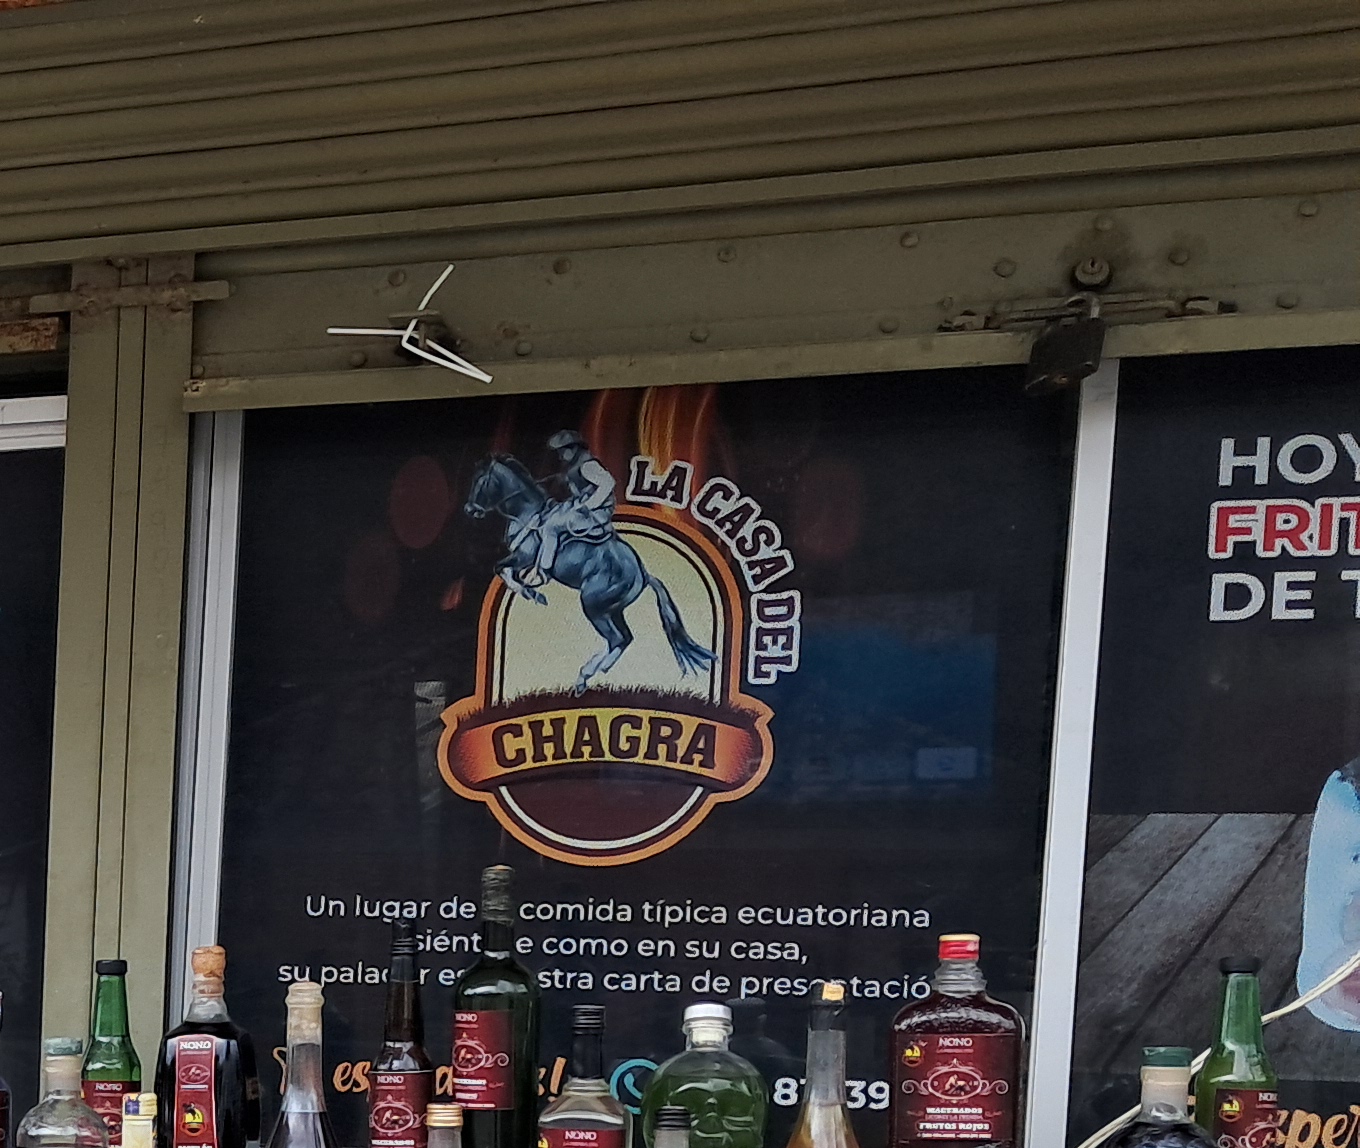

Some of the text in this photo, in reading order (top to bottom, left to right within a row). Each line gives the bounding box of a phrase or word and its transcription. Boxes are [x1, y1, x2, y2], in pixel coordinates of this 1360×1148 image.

[626, 455, 801, 685] LA CASA DEL
[1209, 570, 1317, 621] DE
[492, 714, 716, 770] CHAGRA
[305, 895, 930, 928] Un lugar de comida típica ecuatoriana
[542, 938, 628, 956] como
[637, 940, 675, 957] en
[684, 941, 720, 959] su
[730, 941, 808, 965] casa,
[277, 964, 310, 983] su
[603, 970, 680, 992] carta
[691, 969, 730, 994] de
[180, 1041, 212, 1050] NONO
[938, 1037, 973, 1047] NONO
[565, 1130, 597, 1140] NONO
